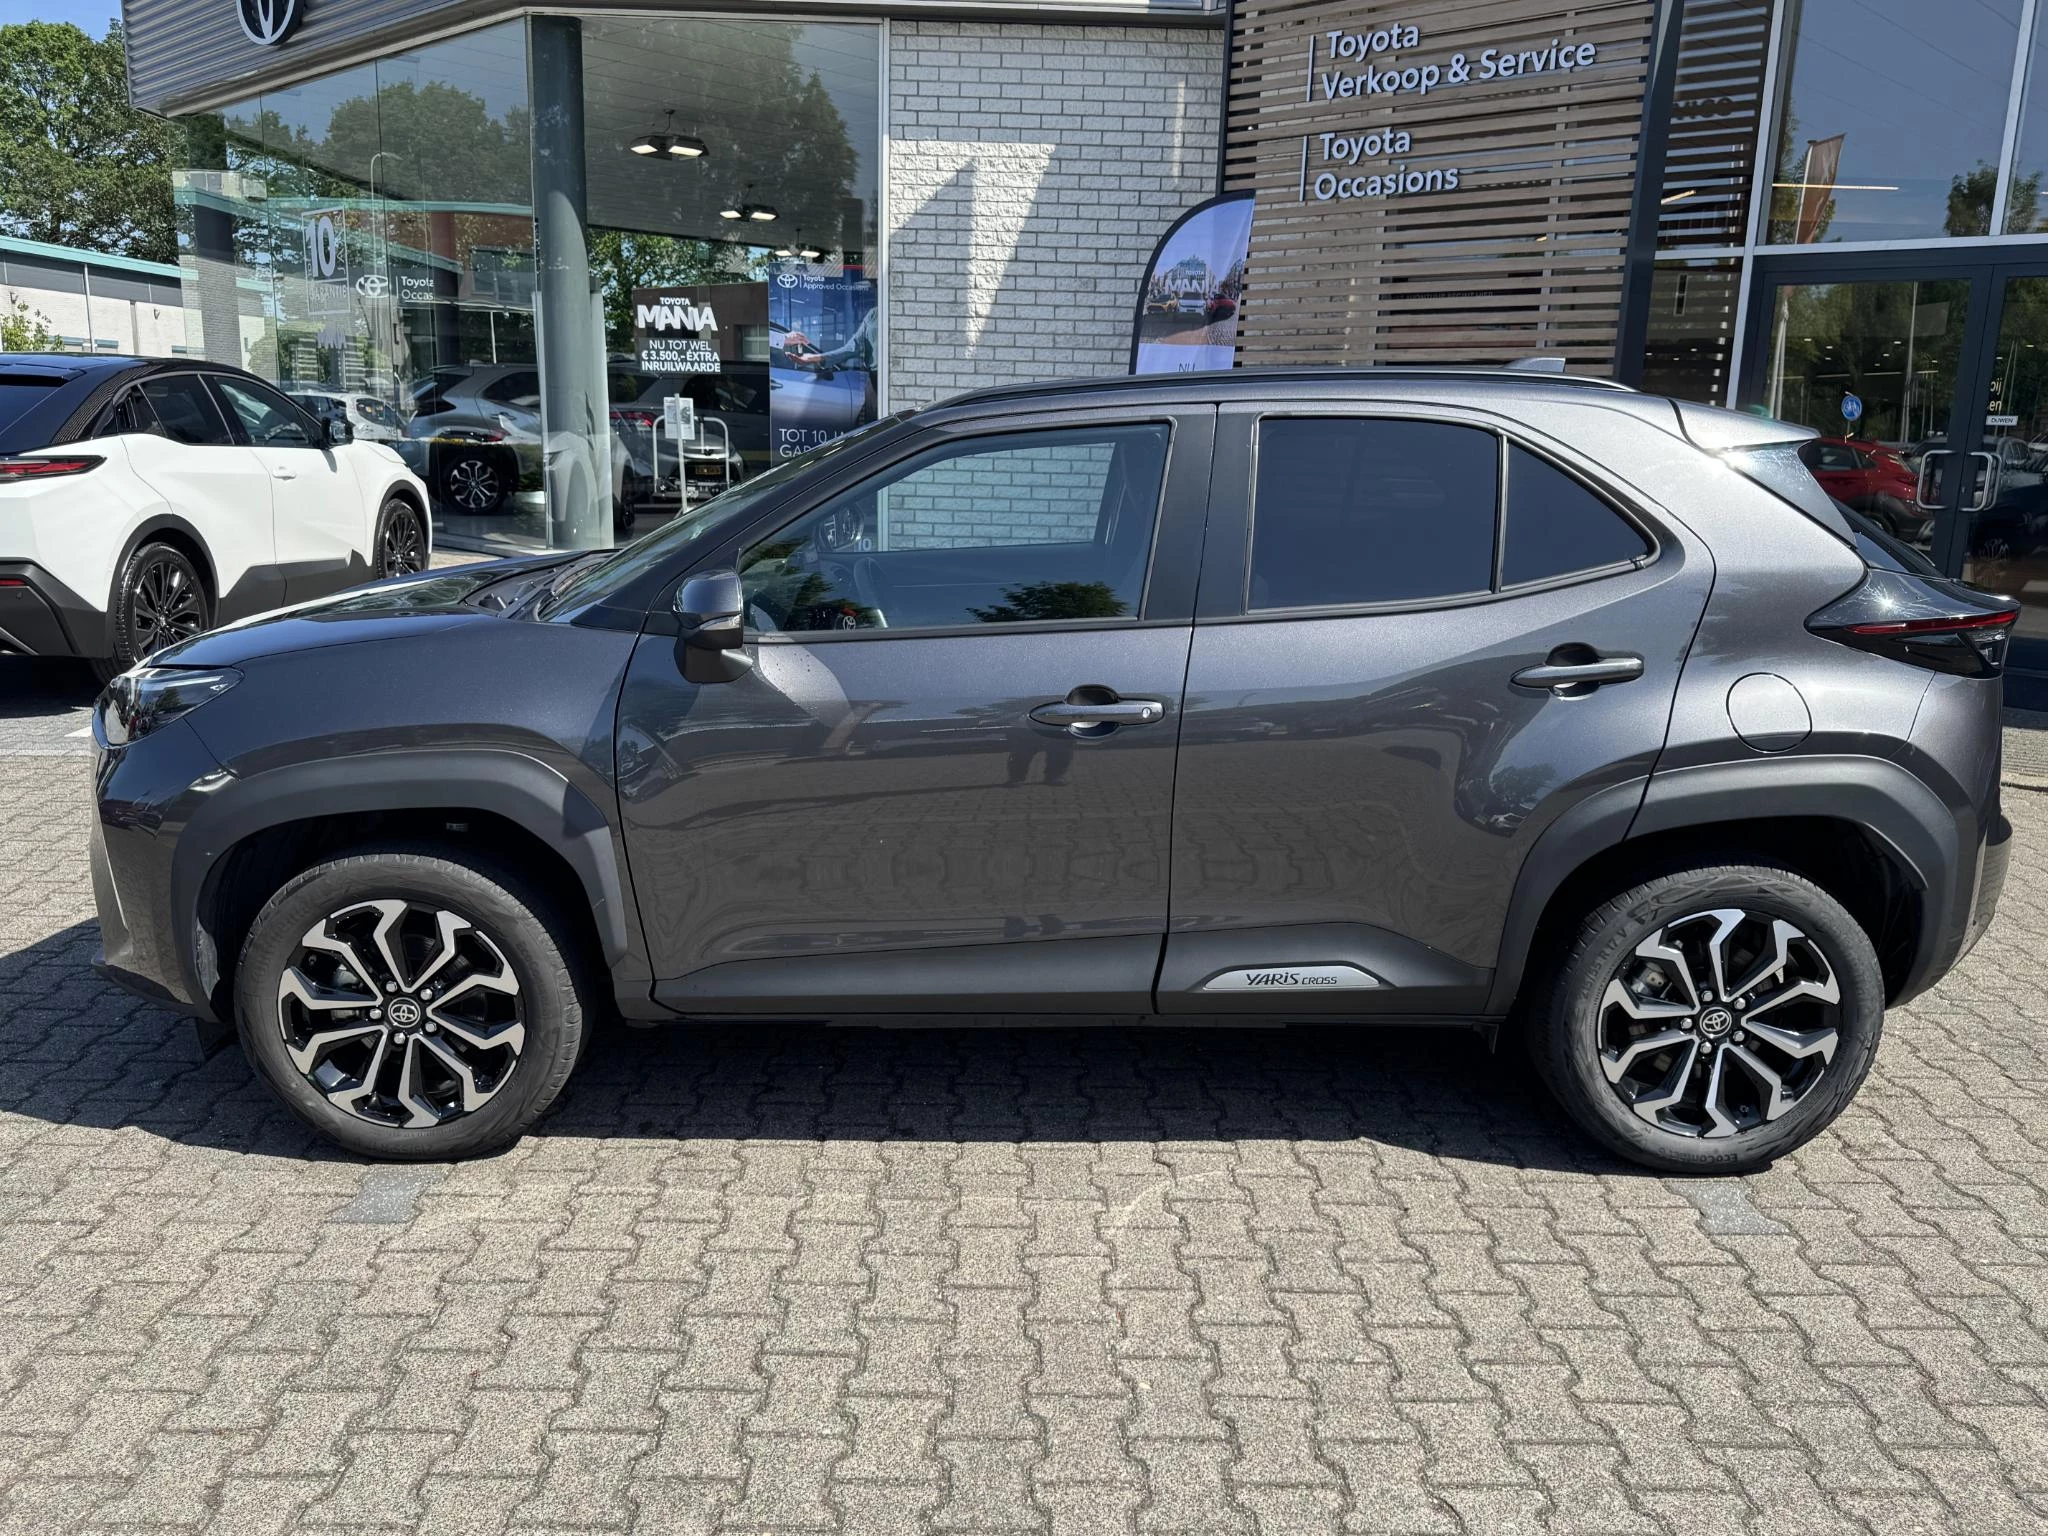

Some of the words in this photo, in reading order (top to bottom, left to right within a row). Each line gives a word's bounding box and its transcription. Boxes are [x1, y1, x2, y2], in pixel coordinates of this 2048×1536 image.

[1327, 23, 1420, 63] Toyota
[1321, 64, 1441, 100] Verkoop
[1447, 53, 1471, 84] &
[1478, 38, 1597, 80] Service
[1319, 127, 1412, 165] Toyota
[1314, 164, 1460, 201] Occasions
[305, 215, 336, 278] 10
[803, 273, 825, 283] Toyota
[803, 282, 834, 291] Approved
[659, 296, 691, 306] TOYOTA
[637, 304, 719, 332] MANIA
[649, 339, 666, 350] NU
[667, 339, 688, 350] TOT
[689, 340, 712, 351] WEL
[641, 360, 721, 373] INRUILWAARDE
[778, 428, 808, 443] TOT
[811, 430, 828, 445] 10
[1301, 976, 1338, 985] CROSS
